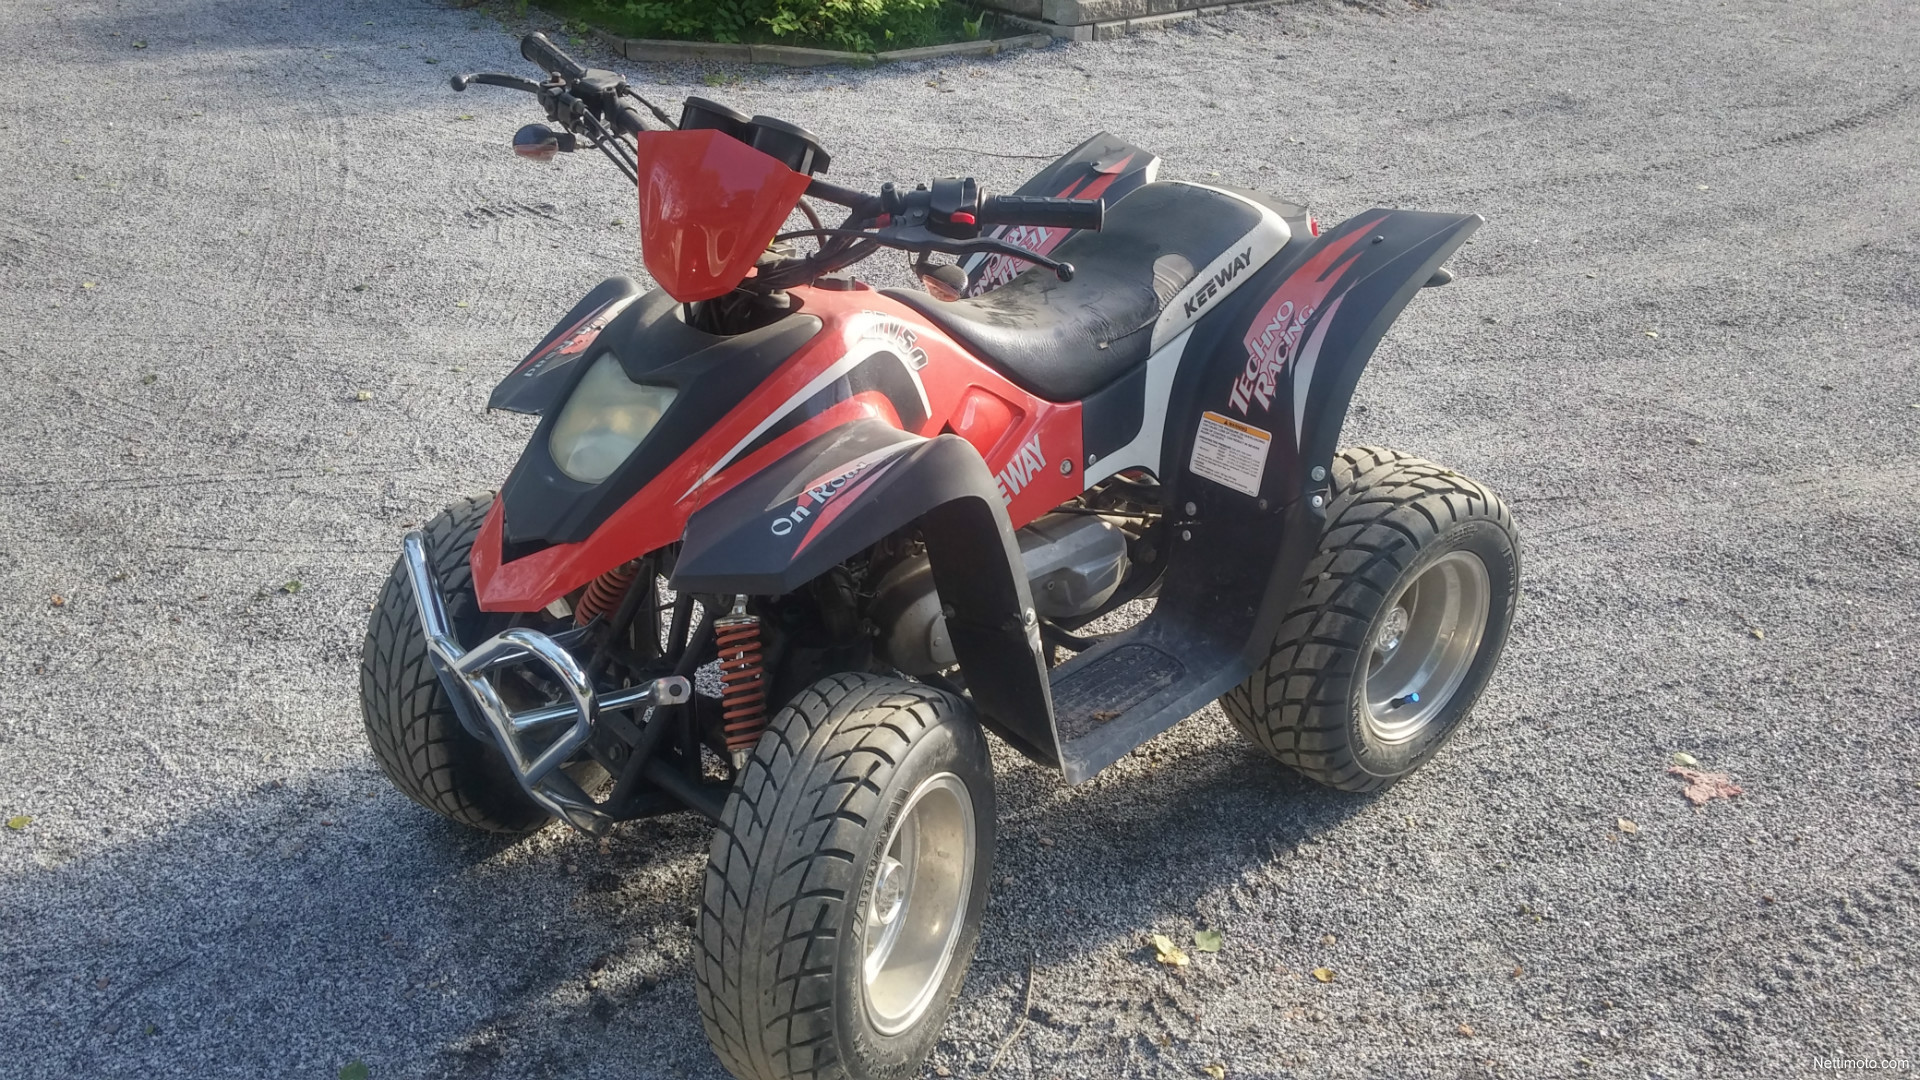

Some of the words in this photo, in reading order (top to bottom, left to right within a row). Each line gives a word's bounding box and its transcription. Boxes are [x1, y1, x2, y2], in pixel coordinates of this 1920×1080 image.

[1183, 246, 1253, 318] KEEWAY
[994, 432, 1047, 507] EWAY
[771, 505, 811, 536] On
